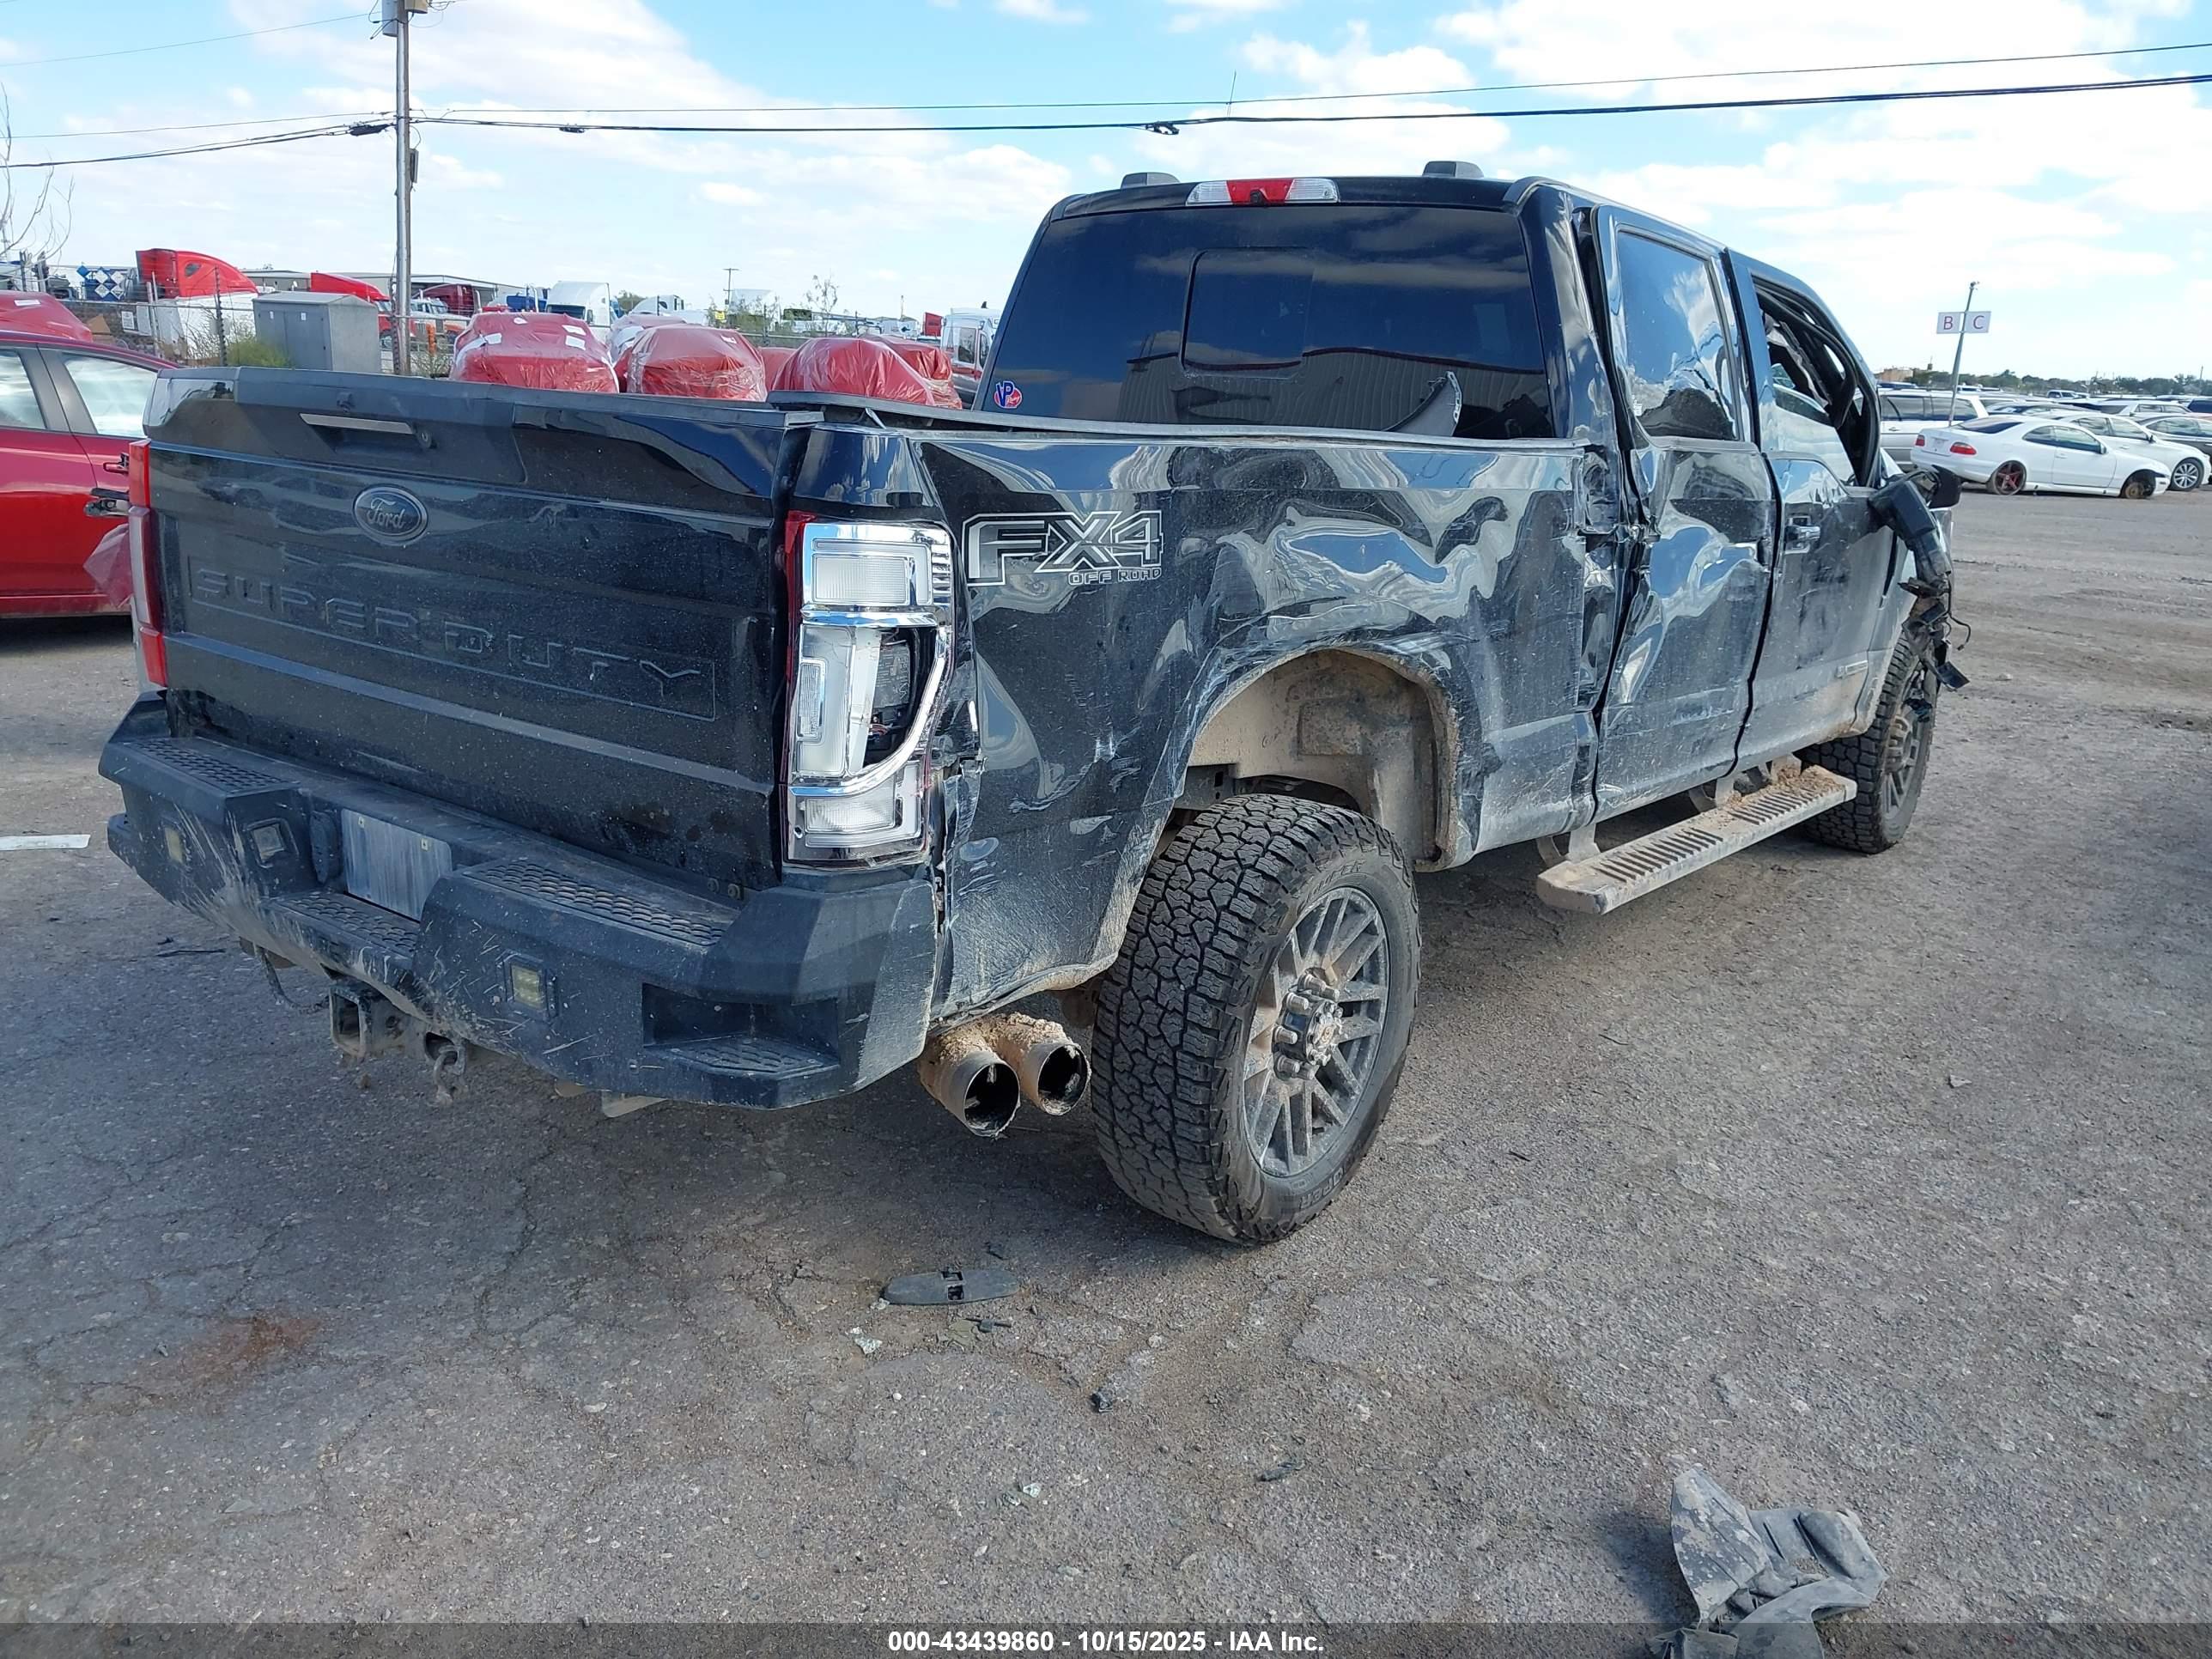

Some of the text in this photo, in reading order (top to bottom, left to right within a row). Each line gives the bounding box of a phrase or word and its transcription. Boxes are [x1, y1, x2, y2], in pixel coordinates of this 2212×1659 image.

[1943, 316, 1954, 331] B
[1972, 315, 1985, 330] C
[996, 381, 1014, 408] VP
[367, 497, 407, 530] Ford
[961, 510, 1164, 586] FX4
[1068, 567, 1162, 586] OFF ROAD
[194, 567, 702, 701] SUPER DUTY
